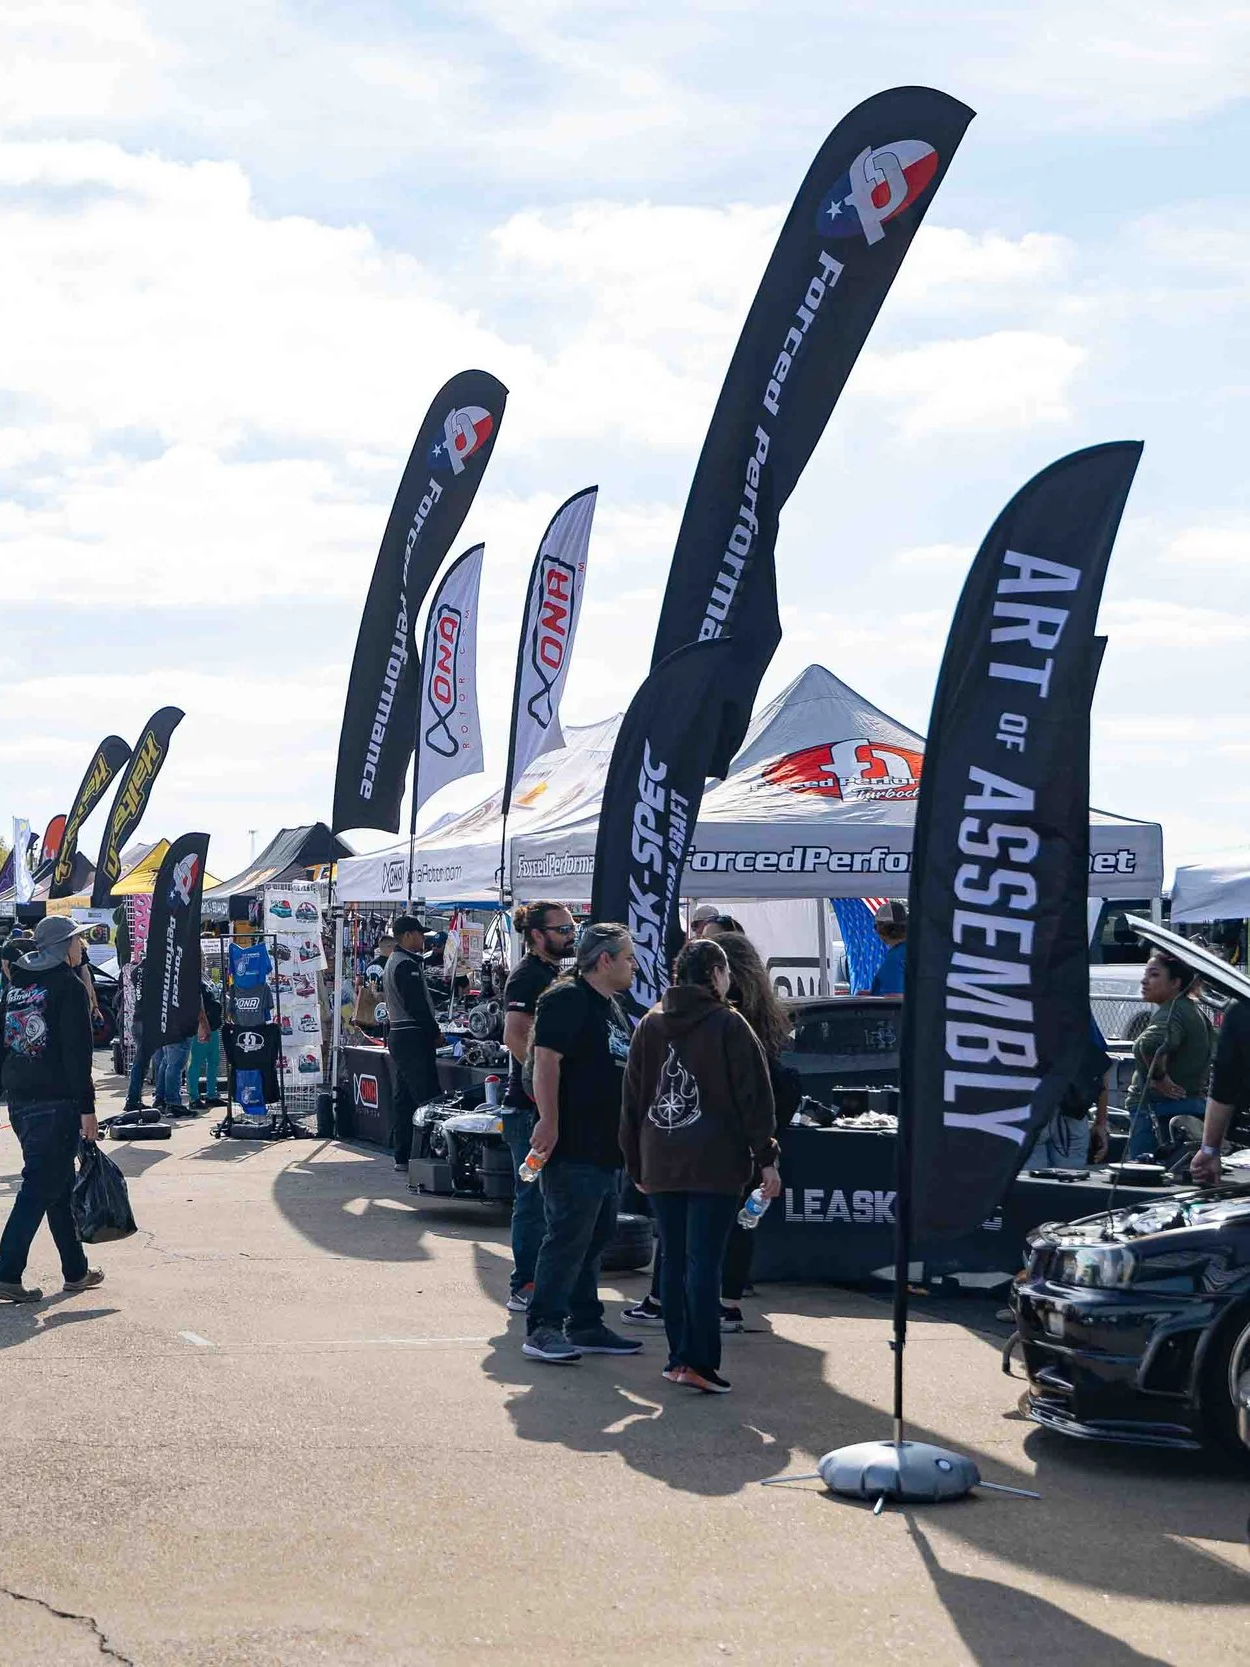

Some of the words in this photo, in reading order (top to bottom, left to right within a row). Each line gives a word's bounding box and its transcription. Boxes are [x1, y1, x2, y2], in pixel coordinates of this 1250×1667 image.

[762, 250, 845, 416] Forced
[698, 424, 771, 641] Performa
[988, 549, 1082, 699] ART
[995, 712, 1029, 754] OF
[839, 776, 921, 787] Perfor
[668, 789, 690, 857] CRAFT
[516, 851, 594, 879] ForcedPerforma
[627, 738, 668, 1028] EASK-SPEC
[171, 945, 183, 1010] Forced
[943, 765, 1045, 1148] ASSEMBLY
[784, 1187, 898, 1224] LEASK
